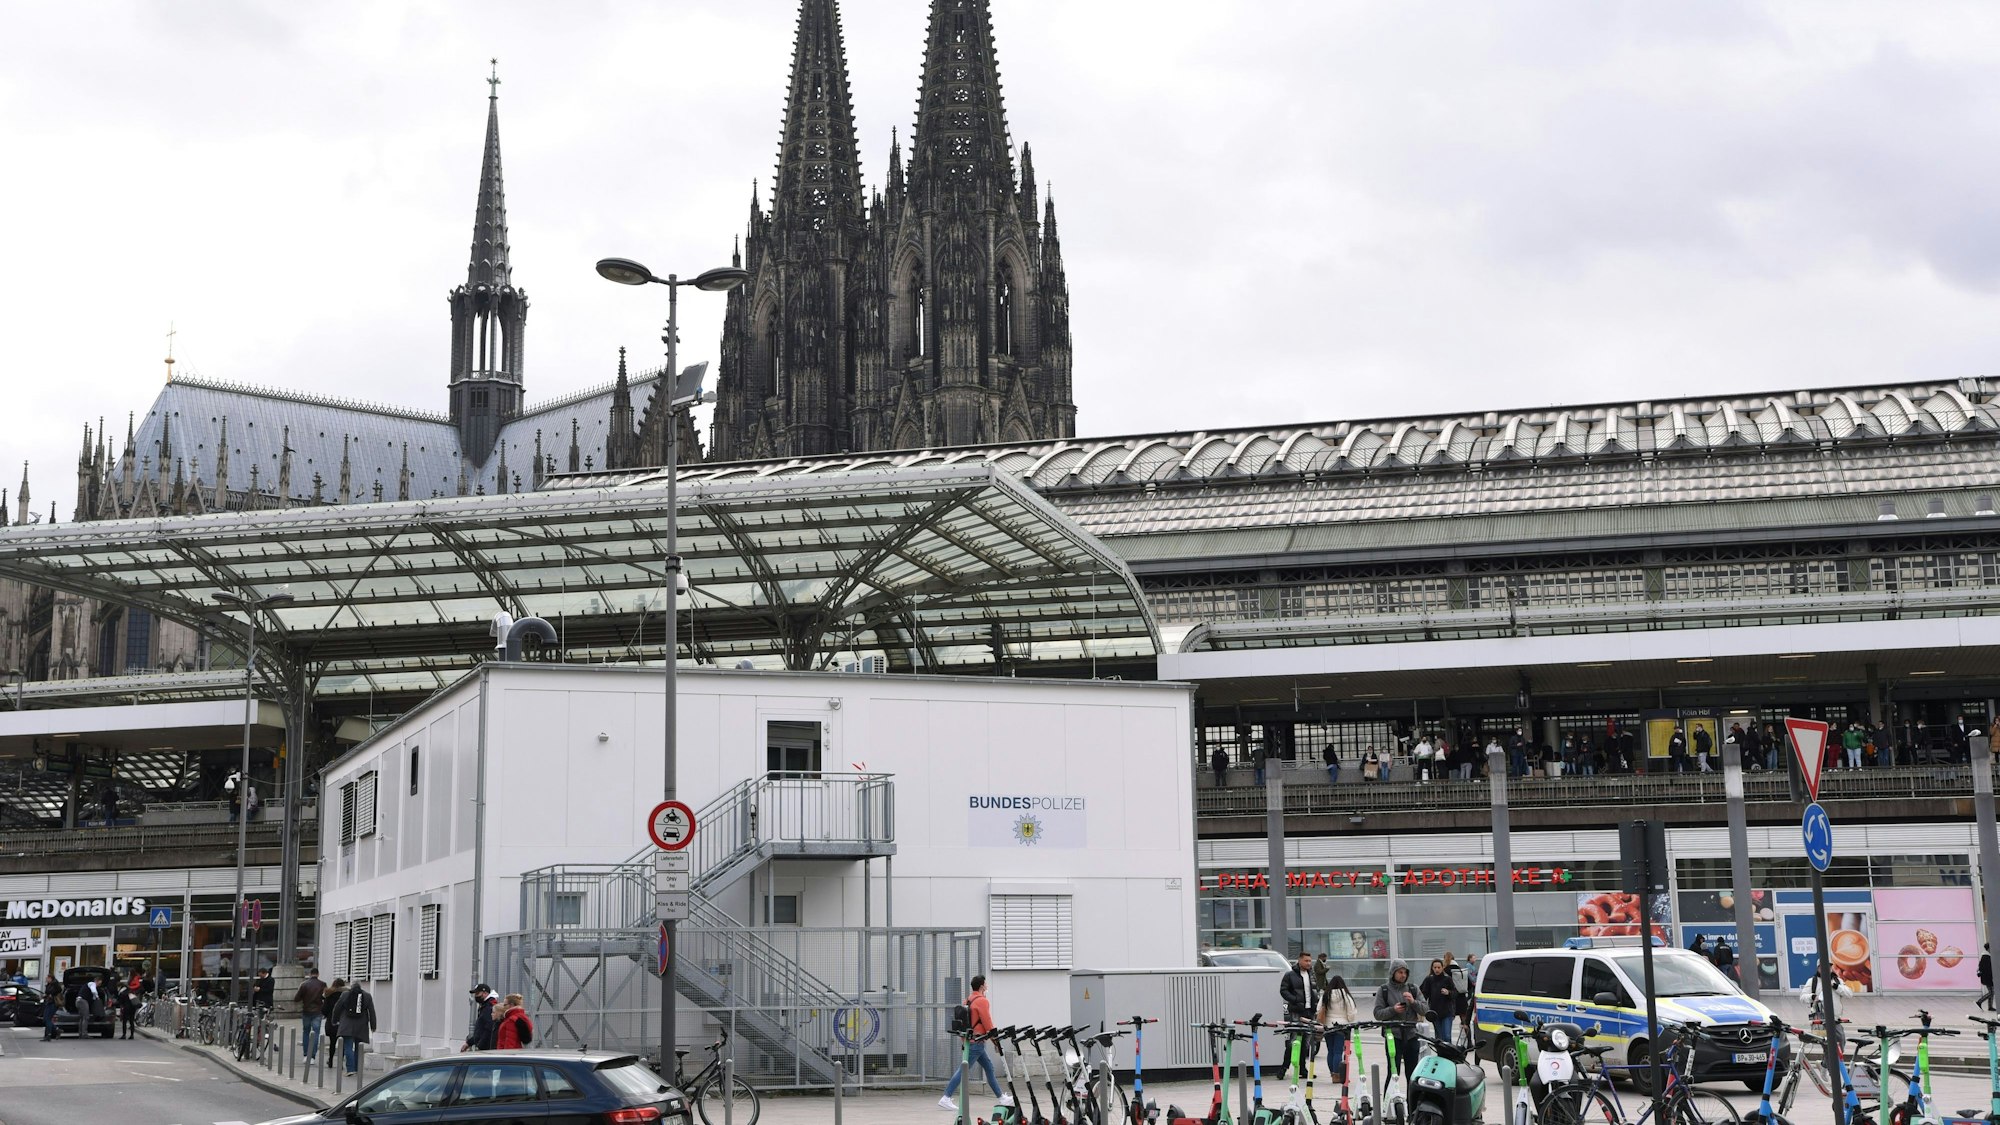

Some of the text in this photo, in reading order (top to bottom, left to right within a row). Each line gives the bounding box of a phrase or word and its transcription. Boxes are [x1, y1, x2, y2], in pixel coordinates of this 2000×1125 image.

[969, 796, 1085, 811] BUNDESPOLIZEI
[1218, 871, 1361, 890] PHAMACY
[1403, 867, 1542, 887] APOTHKE
[6, 896, 147, 919] McDonald's
